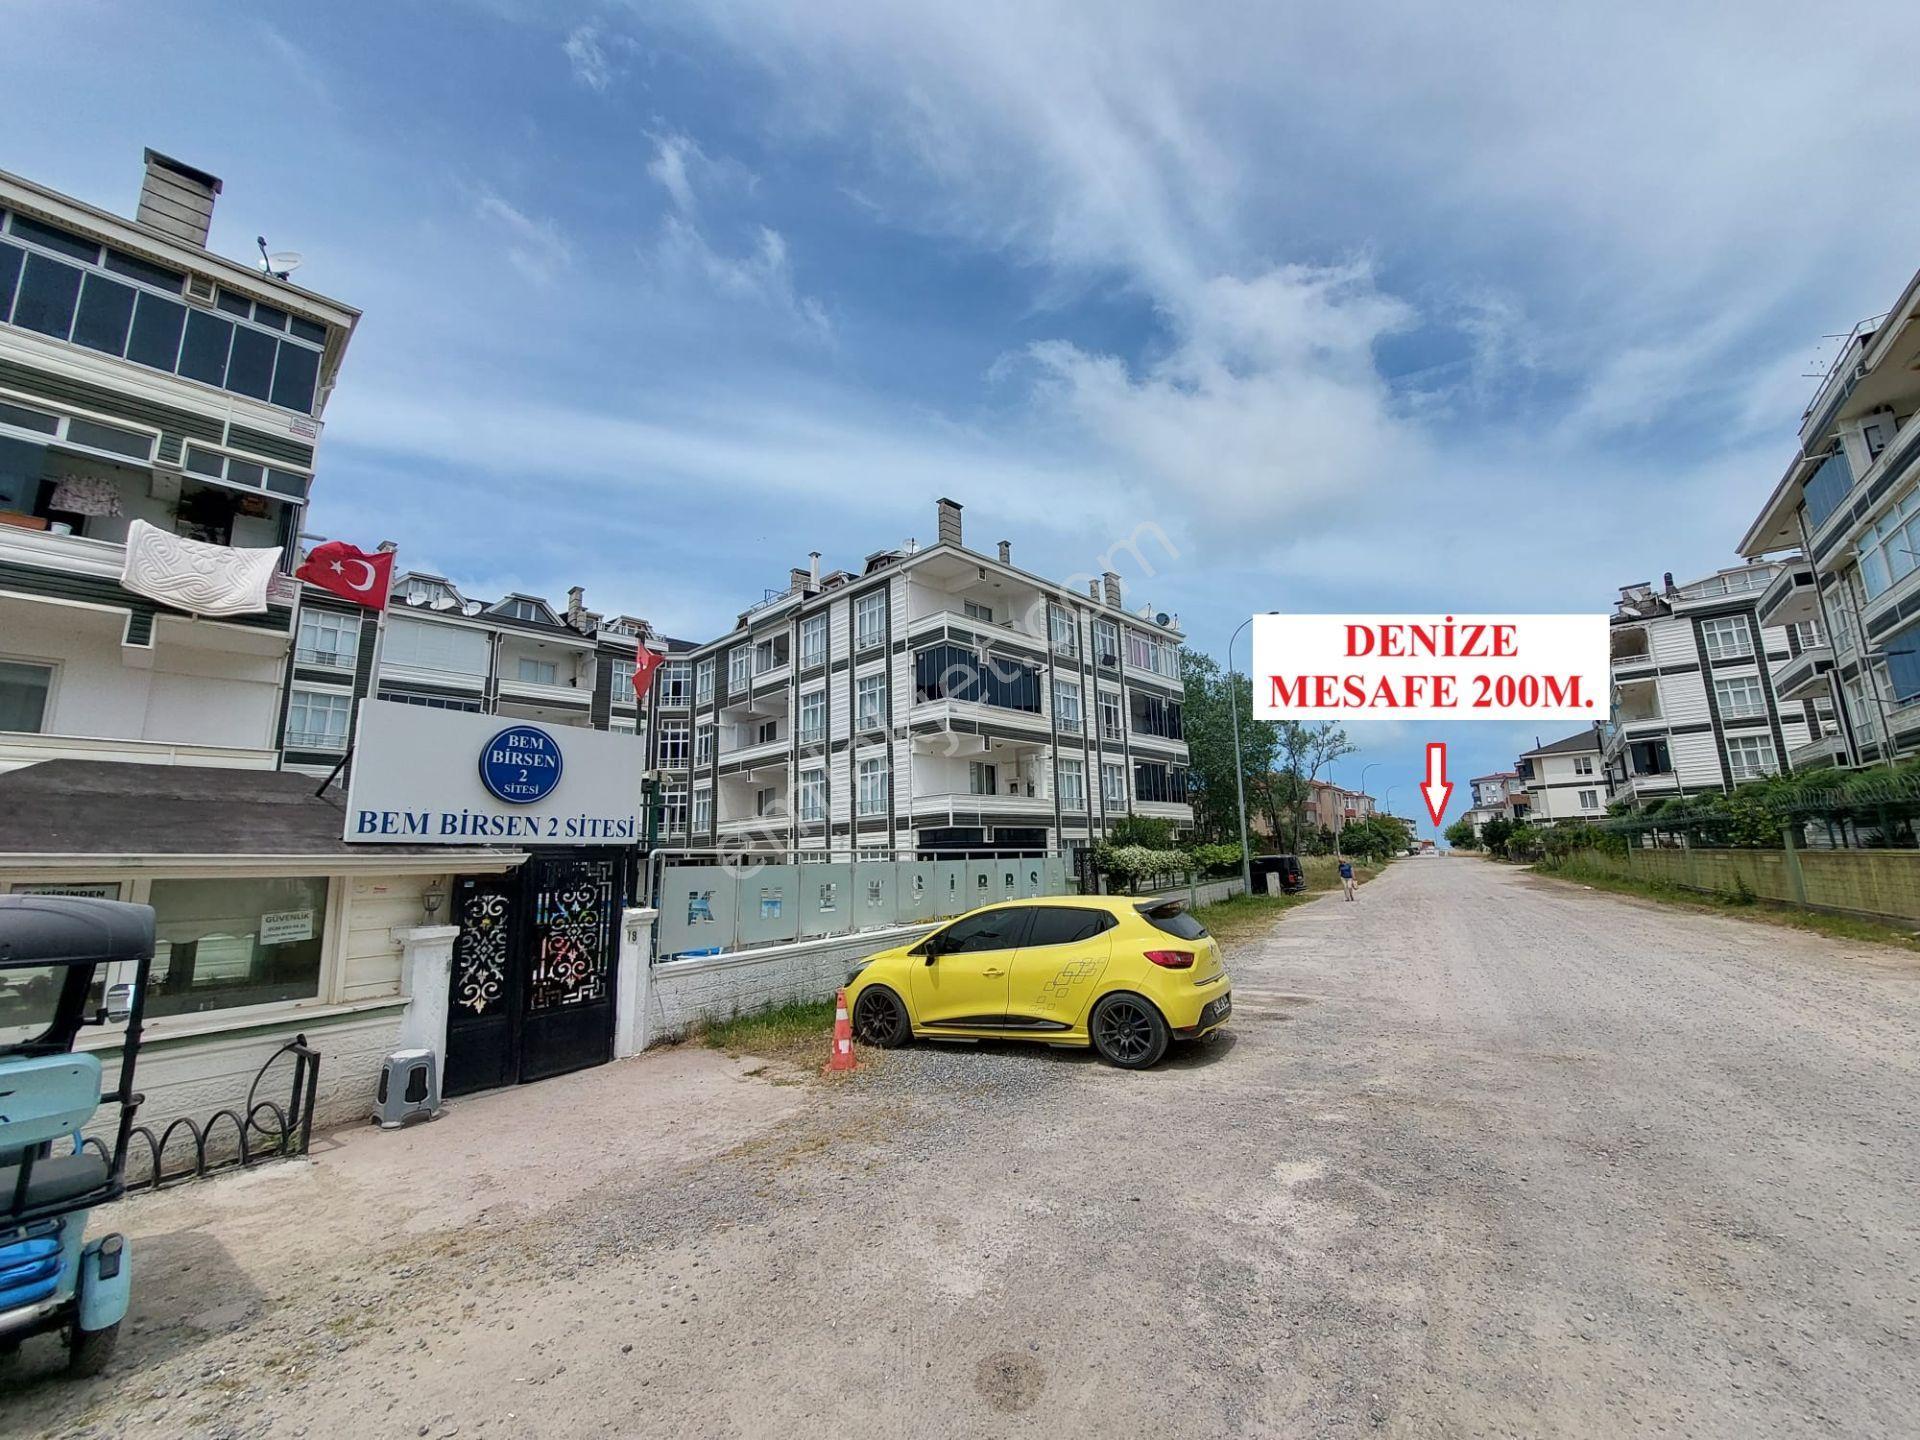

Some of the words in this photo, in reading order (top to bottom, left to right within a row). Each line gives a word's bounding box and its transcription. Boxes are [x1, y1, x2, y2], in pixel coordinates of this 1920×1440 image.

[508, 734, 544, 750] BEM
[492, 748, 557, 769] BİRSEN
[518, 769, 528, 782] 2
[503, 783, 540, 795] SİTESİ
[357, 810, 430, 835] BEM
[440, 808, 541, 837] BİRSEN
[546, 817, 559, 837] 2
[565, 813, 636, 838] SİTESİ
[265, 912, 310, 923] GÜVENLİK
